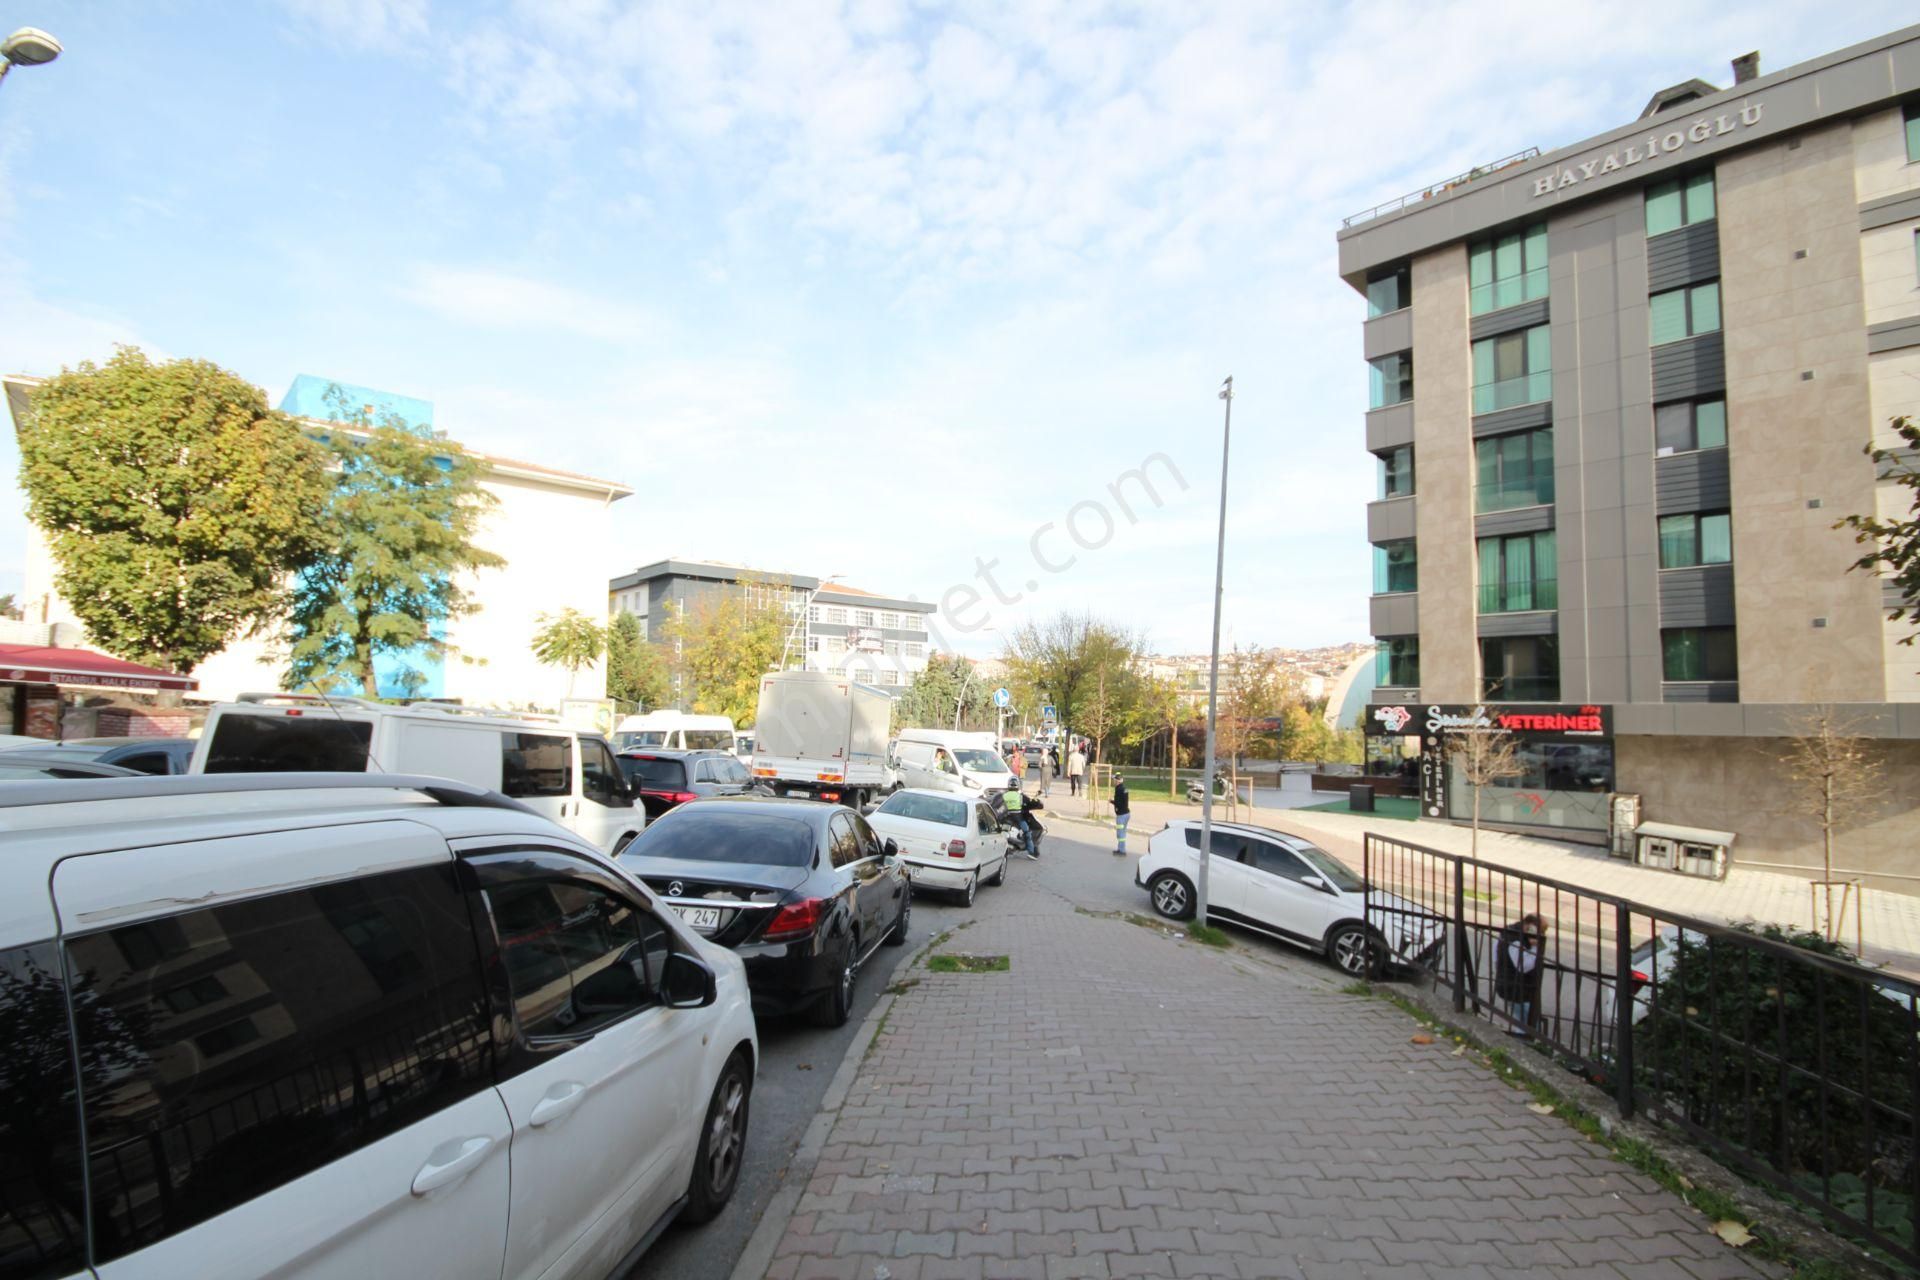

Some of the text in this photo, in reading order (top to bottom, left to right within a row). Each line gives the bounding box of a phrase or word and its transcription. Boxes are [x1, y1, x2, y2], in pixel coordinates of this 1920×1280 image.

[101, 677, 127, 687] HALK
[129, 679, 161, 689] EKMEK
[1498, 712, 1602, 731] VETERİNER
[693, 909, 717, 925] 247
